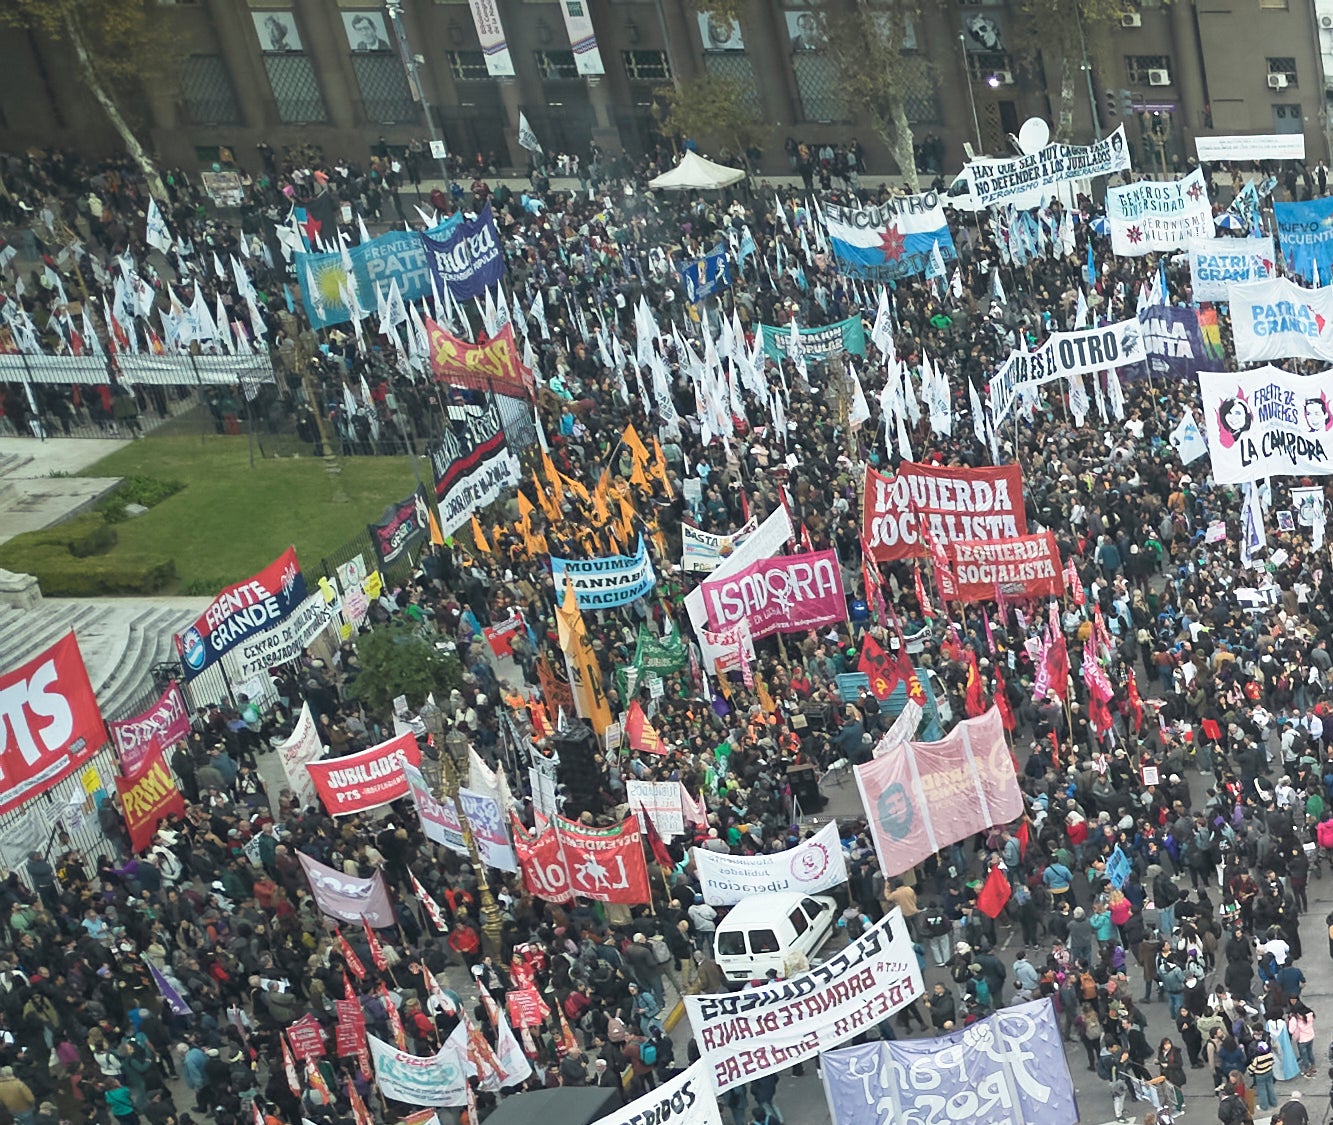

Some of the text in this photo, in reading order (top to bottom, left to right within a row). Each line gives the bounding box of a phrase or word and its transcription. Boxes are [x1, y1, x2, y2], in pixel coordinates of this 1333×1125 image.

[971, 165, 994, 181] HAY
[998, 161, 1016, 175] QUE
[1019, 156, 1036, 169] SER
[1040, 145, 1058, 163] MUY
[975, 149, 1112, 196] NO DEFENDER A LOS JUBILADOS
[825, 190, 938, 229] ENCUENTRO
[1251, 300, 1311, 320] PATRIA
[1253, 316, 1319, 338] GRANDE
[1059, 331, 1118, 370] OTRO
[1240, 438, 1259, 467] LA
[874, 474, 1013, 513] IZQUIERDA
[871, 511, 1020, 548] SOCALISTA
[954, 538, 1050, 565] IZQUIERDA
[957, 559, 1056, 585] SOCIALISTA
[205, 580, 271, 631] FRENTE
[709, 558, 838, 625] ISADORA
[210, 596, 281, 651] GRANDE
[244, 635, 280, 660] CENTRO
[283, 626, 292, 643] DE
[328, 748, 409, 790] JUBILADES
[336, 788, 361, 803] PTS
